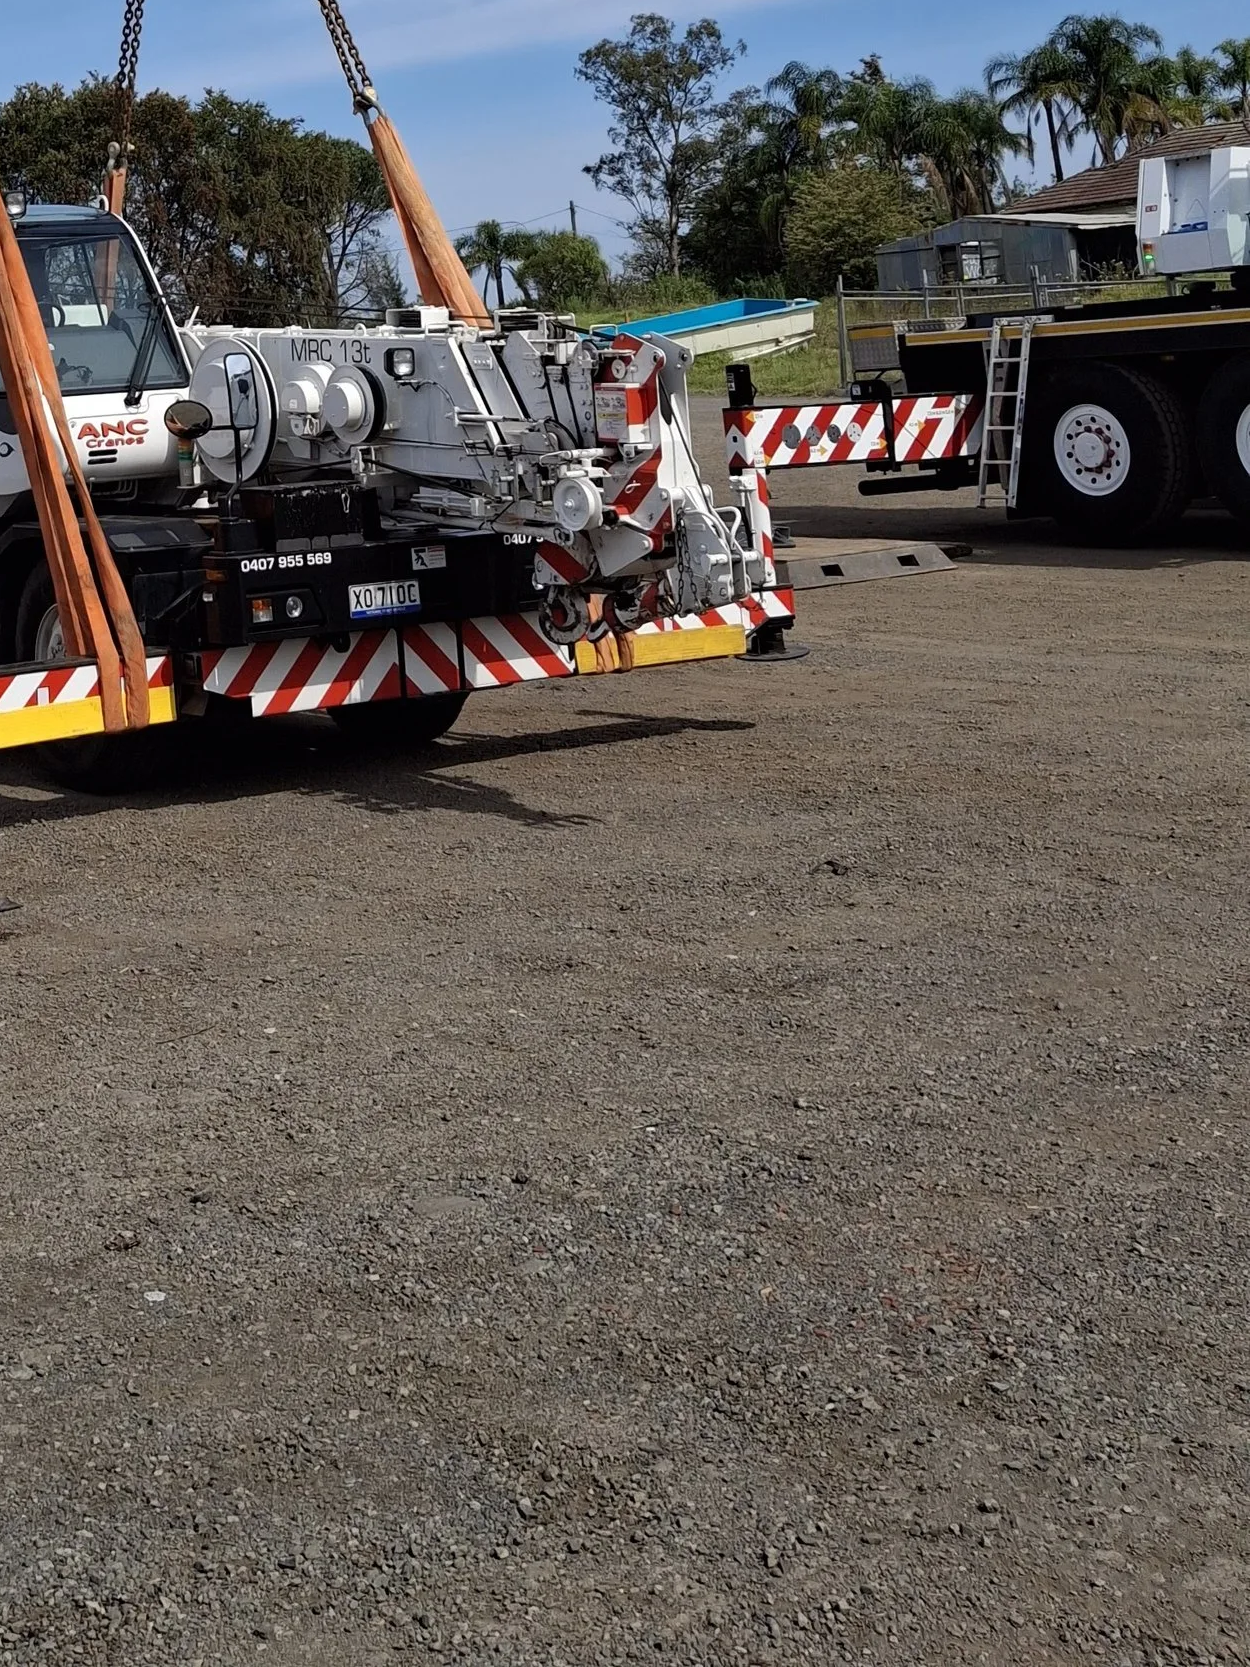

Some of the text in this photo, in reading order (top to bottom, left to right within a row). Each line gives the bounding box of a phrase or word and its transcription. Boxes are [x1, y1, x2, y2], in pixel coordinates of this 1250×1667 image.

[291, 338, 372, 364] MRC 13t
[77, 418, 150, 440] ANC
[240, 552, 332, 573] 0407 955 569
